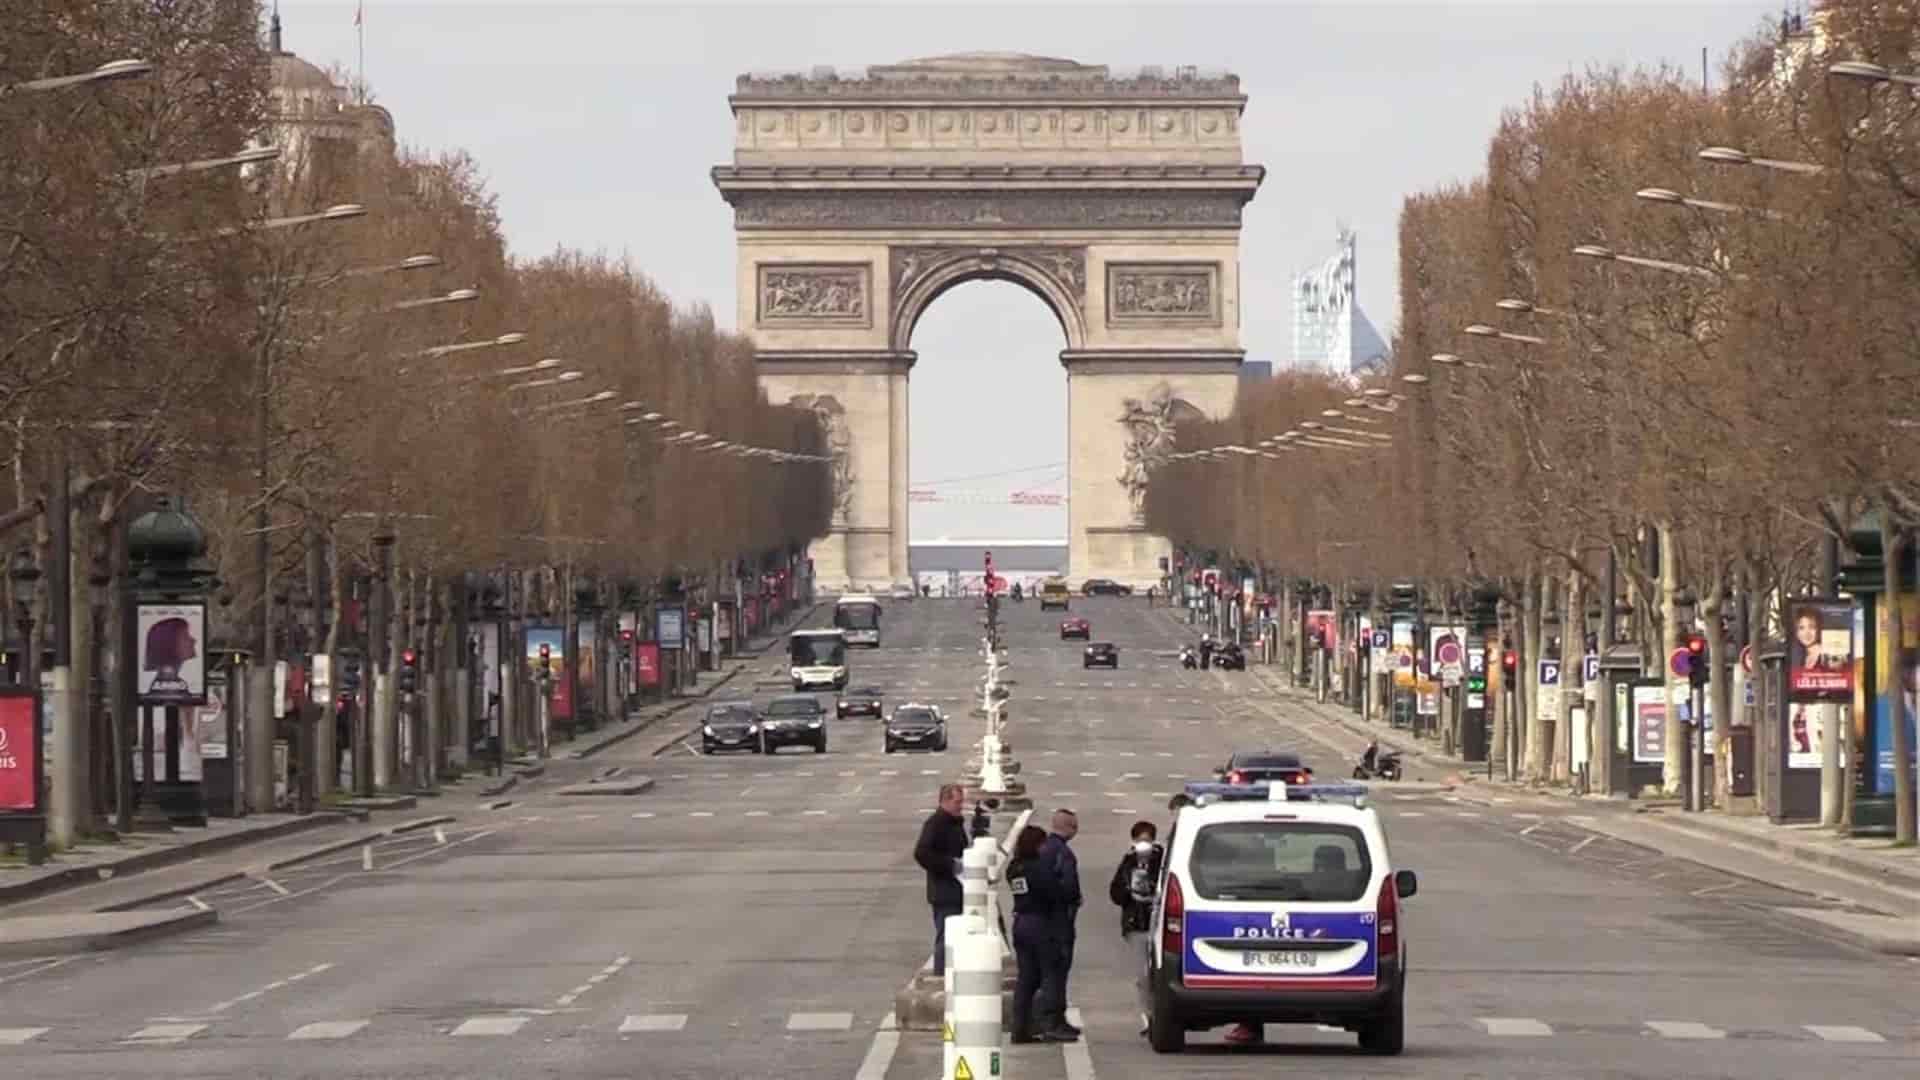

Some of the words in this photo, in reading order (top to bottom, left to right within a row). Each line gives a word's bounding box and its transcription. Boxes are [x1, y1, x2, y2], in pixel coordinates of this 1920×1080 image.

[1376, 635, 1385, 646] P
[1545, 665, 1557, 681] P
[1233, 927, 1305, 938] POLICE
